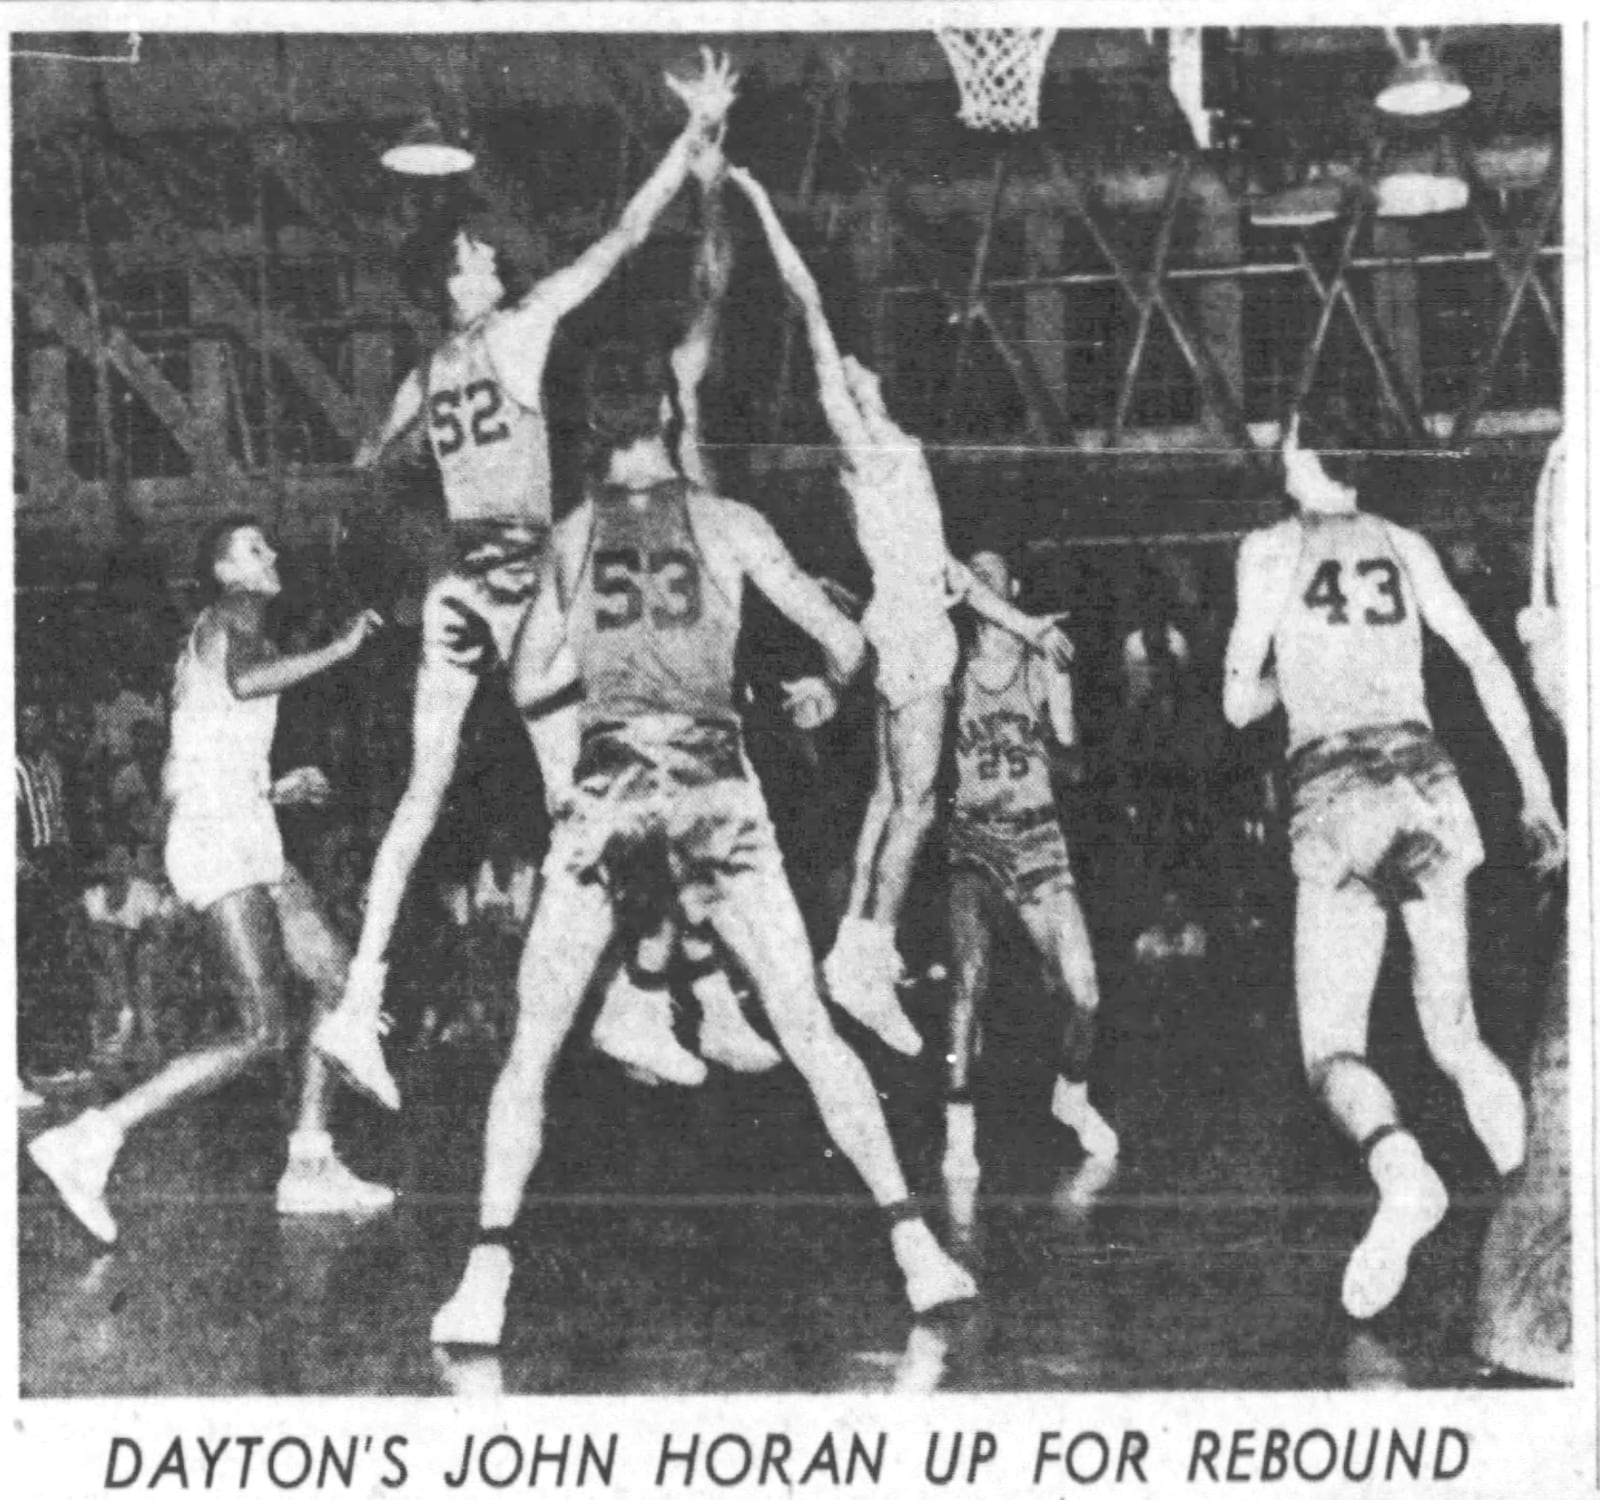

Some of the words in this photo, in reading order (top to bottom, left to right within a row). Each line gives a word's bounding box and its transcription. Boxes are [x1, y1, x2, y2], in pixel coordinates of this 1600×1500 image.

[429, 380, 510, 456] 52
[593, 548, 701, 632] 53
[1303, 557, 1406, 624] 43
